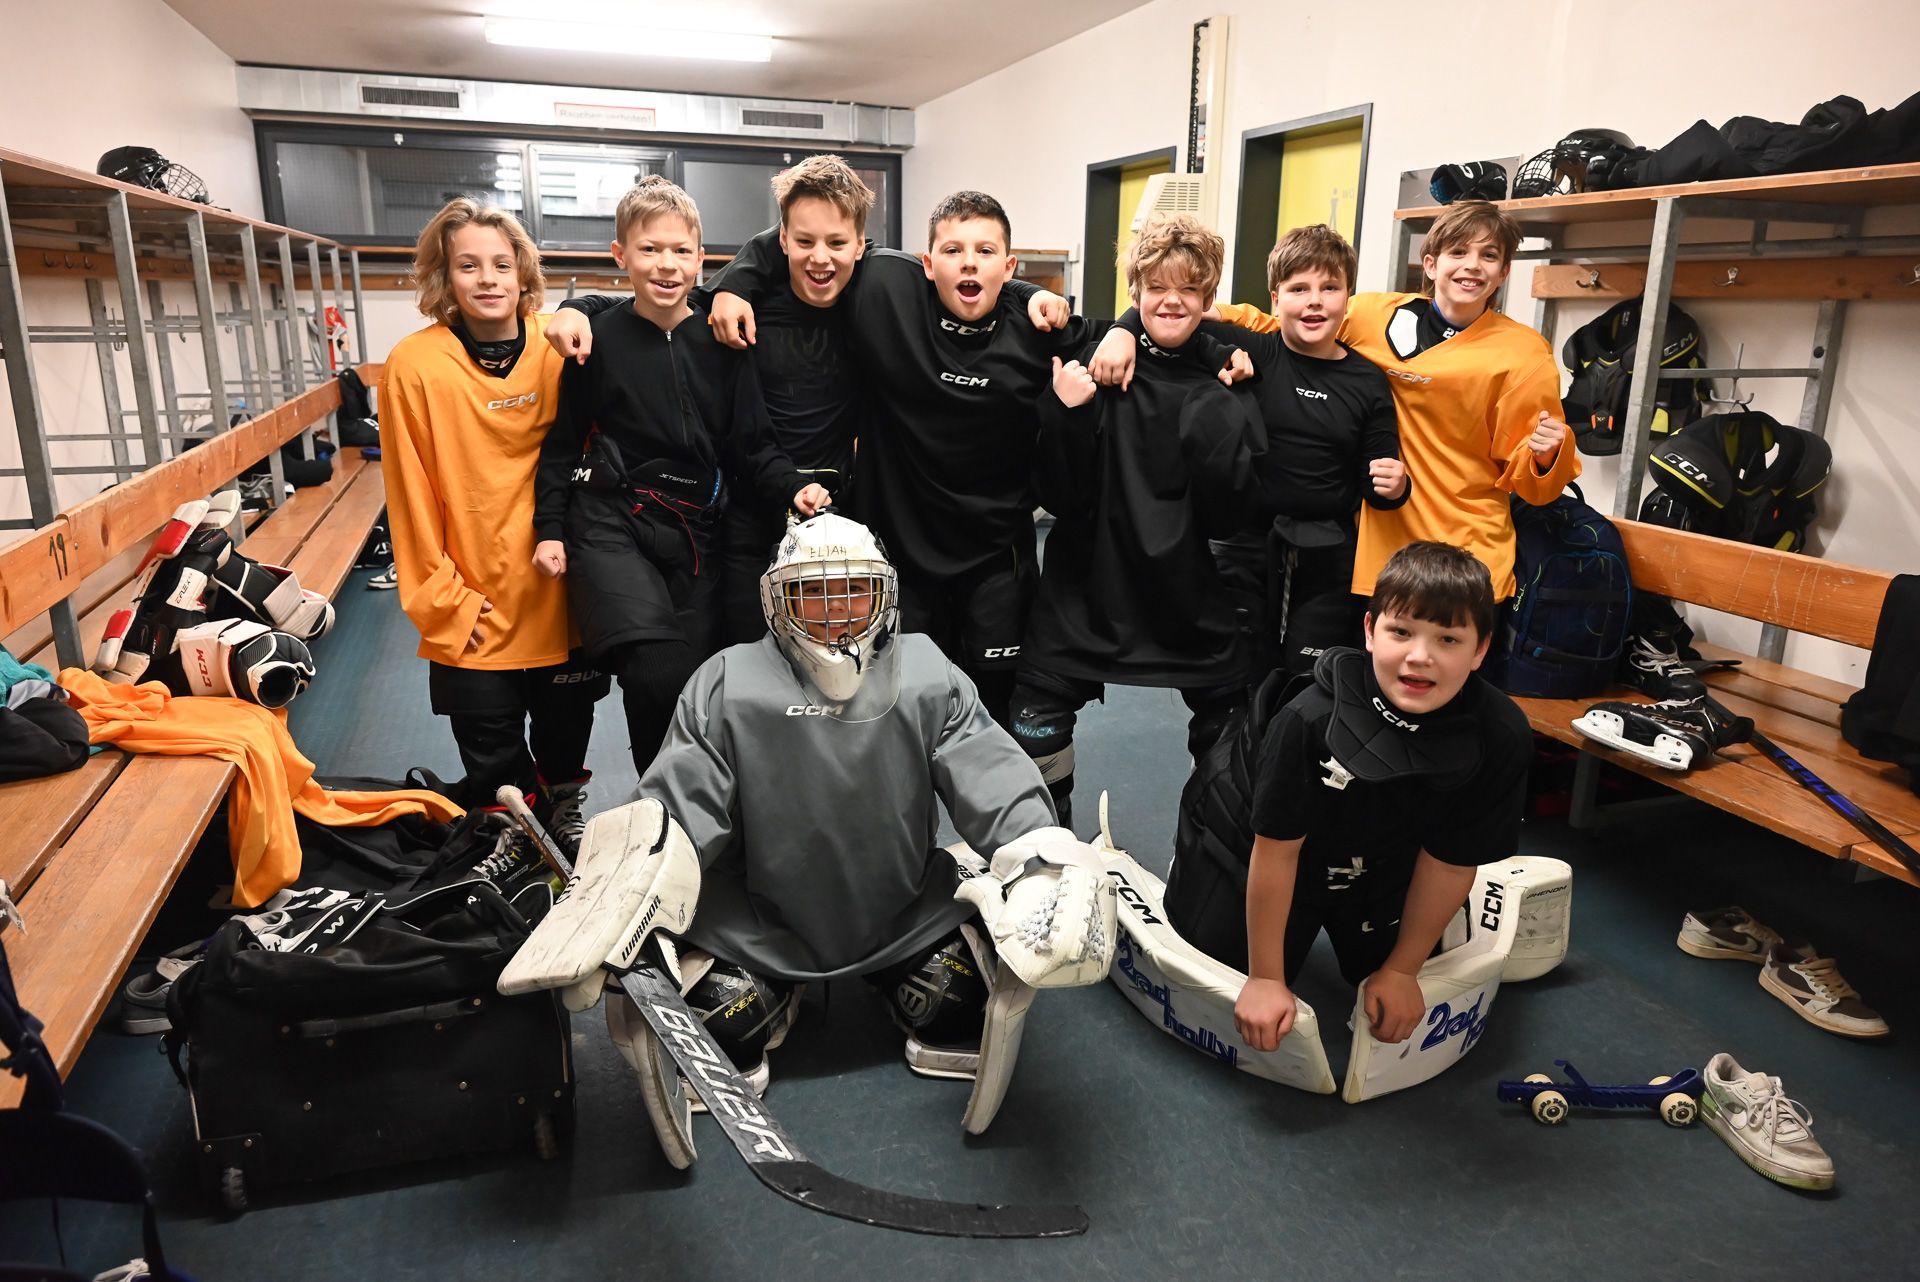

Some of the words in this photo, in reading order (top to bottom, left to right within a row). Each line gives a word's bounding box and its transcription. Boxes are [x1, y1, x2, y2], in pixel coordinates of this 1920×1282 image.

[479, 354, 514, 369] CC
[940, 371, 990, 387] CCM
[1386, 368, 1433, 384] CCM
[487, 392, 537, 410] CCM
[1295, 387, 1328, 401] CCM
[1664, 452, 1717, 488] CCM
[49, 532, 69, 581] 19
[809, 544, 848, 559] ELIAH
[984, 645, 1021, 658] CC
[195, 648, 213, 689] CCM
[785, 703, 844, 717] CCM
[1372, 697, 1420, 732] CCM
[1106, 870, 1163, 926] CCM
[1480, 880, 1504, 932] CCM
[621, 895, 662, 962] WARRIOR
[651, 1002, 795, 1162] BAUER
